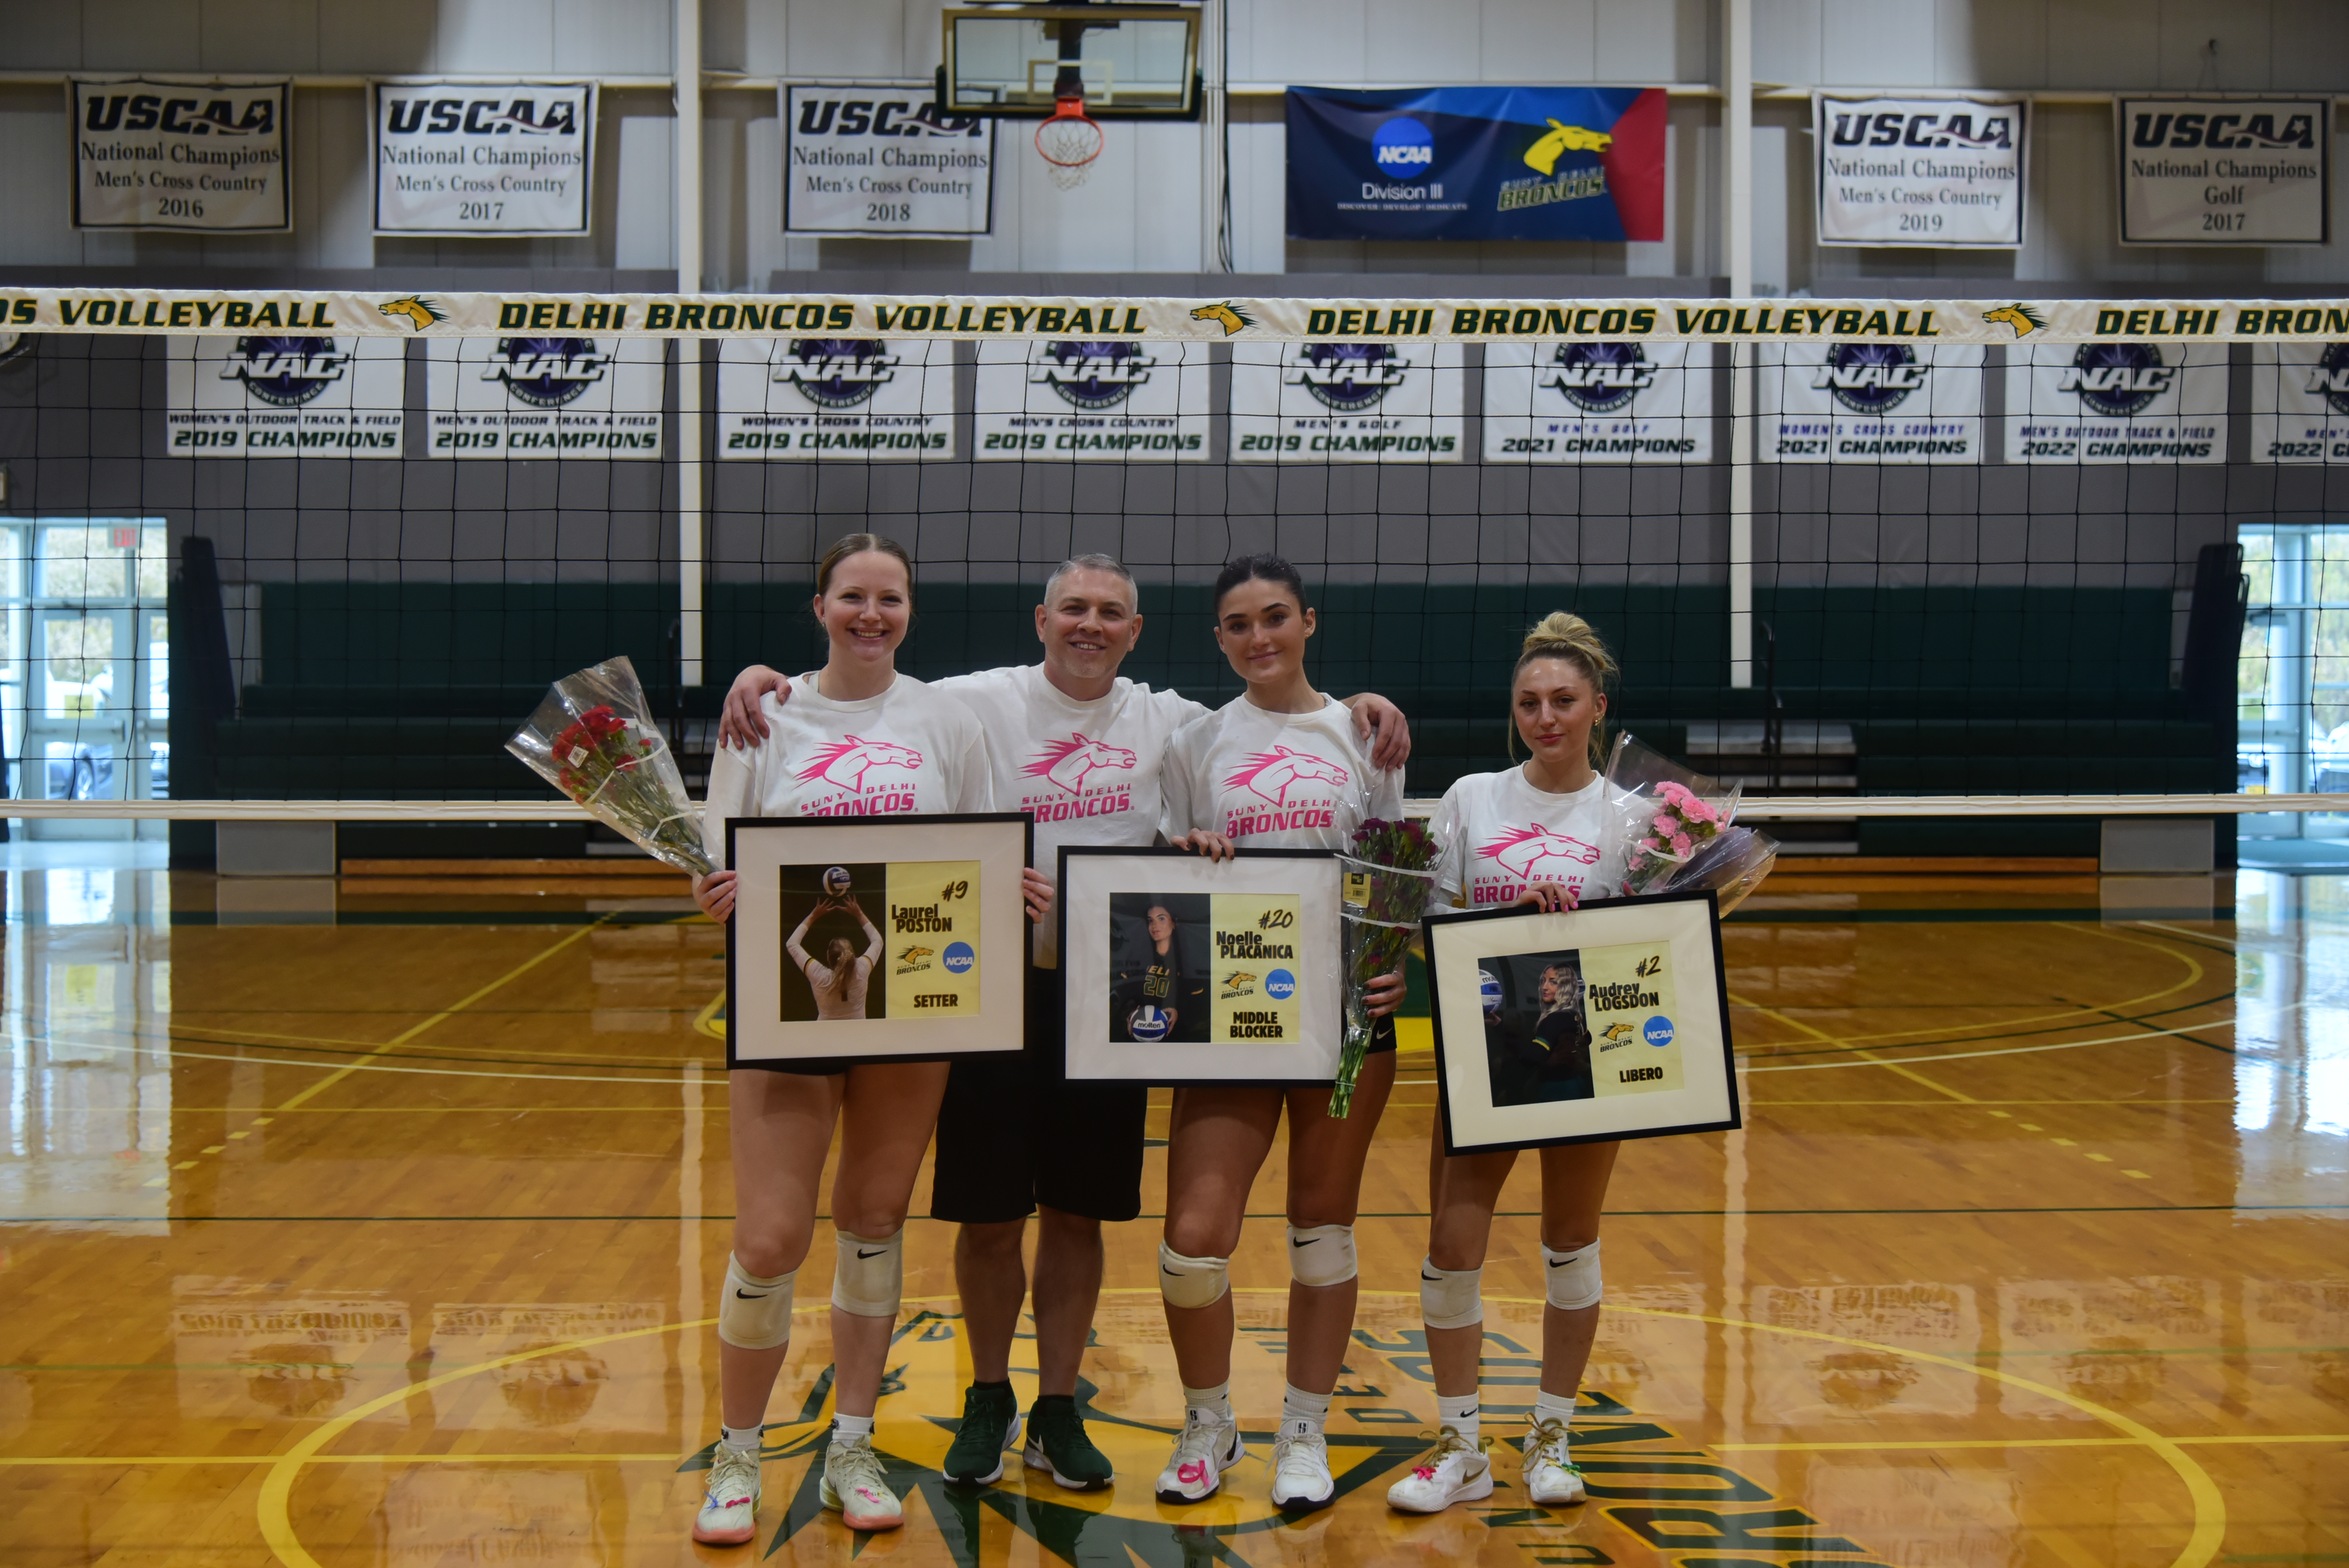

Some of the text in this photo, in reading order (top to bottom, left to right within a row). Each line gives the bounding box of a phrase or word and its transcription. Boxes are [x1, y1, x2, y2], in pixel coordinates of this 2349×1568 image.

[86, 95, 274, 136] USCAA
[388, 99, 576, 135] USCAA
[1832, 113, 2012, 149] USCAA
[2132, 113, 2314, 149] USCAA
[81, 141, 280, 170] National Champions
[382, 145, 582, 170] National Champions
[793, 146, 988, 173] National Champions
[1377, 145, 1433, 164] NCAA
[1827, 158, 2016, 184] National Champions
[2131, 159, 2317, 184] National Champions
[94, 170, 267, 195] Men's Cross Country
[395, 175, 567, 197] Men's Cross Country
[805, 175, 972, 199] Men's Cross Country
[1362, 182, 1443, 200] Division III
[1497, 177, 1604, 212] BRONCOS
[1839, 187, 2003, 211] Men's Cross Country
[2204, 185, 2245, 205] Golf
[158, 197, 204, 218] 2016
[459, 202, 505, 220] 2017
[866, 203, 911, 221] 2018
[1899, 213, 1943, 232] 2019
[2202, 212, 2246, 231] 2017
[57, 298, 336, 328] VOLLEYBALL
[497, 301, 1148, 334] DELHI BRONCOS VOLLEYBALL
[1306, 308, 1941, 336] DELHI BRONCOS VOLLEYBALL
[2095, 308, 2221, 335] DELHI
[219, 352, 349, 380] NAC
[480, 353, 610, 381] NAC
[772, 354, 900, 382] NAC
[1029, 355, 1156, 383] NAC
[1284, 357, 1410, 385] NAC
[1539, 361, 1658, 388] NAC
[1811, 363, 1929, 389] NAC
[2057, 367, 2175, 393] NAC
[169, 414, 401, 425] WOMEN'S OUTDOOR TRACK & FIELD
[434, 415, 657, 426] MEN'S OUTDOOR TRACK & FIELD
[742, 416, 933, 427] WOMEN'S CROSS COUNTRY
[1008, 417, 1176, 428] MEN'S CROSS COUNTRY
[1294, 419, 1403, 429] MEN'S GOLF
[174, 431, 397, 448] 2019 CHAMPIONS
[435, 432, 657, 449] 2019 CHAMPIONS
[728, 433, 947, 449] 2019 CHAMPIONS
[983, 433, 1202, 450] 2019 CHAMPIONS
[1239, 435, 1455, 452] 2019 CHAMPIONS
[1501, 438, 1696, 453] 2021 CHAMPIONS
[1776, 440, 1967, 454] 2021 CHAMPIONS
[2021, 442, 2212, 457] 2022 CHAMPIONS
[2268, 442, 2322, 457] 2022
[801, 783, 916, 813] SUNY DELHI
[1021, 783, 1131, 804] SUNY DELHI
[804, 793, 915, 817] RONCOS
[1020, 793, 1130, 823] RONCOS
[1227, 803, 1268, 819] SUNY
[1226, 809, 1334, 839] BRONCOS
[1474, 874, 1585, 884] SUNY DELHI
[941, 880, 969, 902] #9
[891, 903, 938, 920] Laurel
[1258, 908, 1293, 930] #20
[896, 917, 952, 933] POSTON
[1216, 931, 1263, 946] Noelle
[946, 956, 973, 966] NCAA
[1220, 944, 1294, 959] PLACANICA
[896, 962, 931, 975] BRONCOS
[1635, 955, 1662, 978] #2
[1143, 974, 1170, 998] 20
[1220, 989, 1254, 1000] BRONCOS
[1268, 983, 1294, 992] NCAA
[914, 993, 958, 1008] SETTER
[1594, 991, 1660, 1012] LOGSDON
[1233, 1011, 1278, 1024] MIDDLE
[1229, 1025, 1283, 1038] BLOCKER
[1647, 1029, 1674, 1040] NCAA
[1600, 1038, 1633, 1052] BRONCOS
[1619, 1066, 1663, 1083] LIBERO
